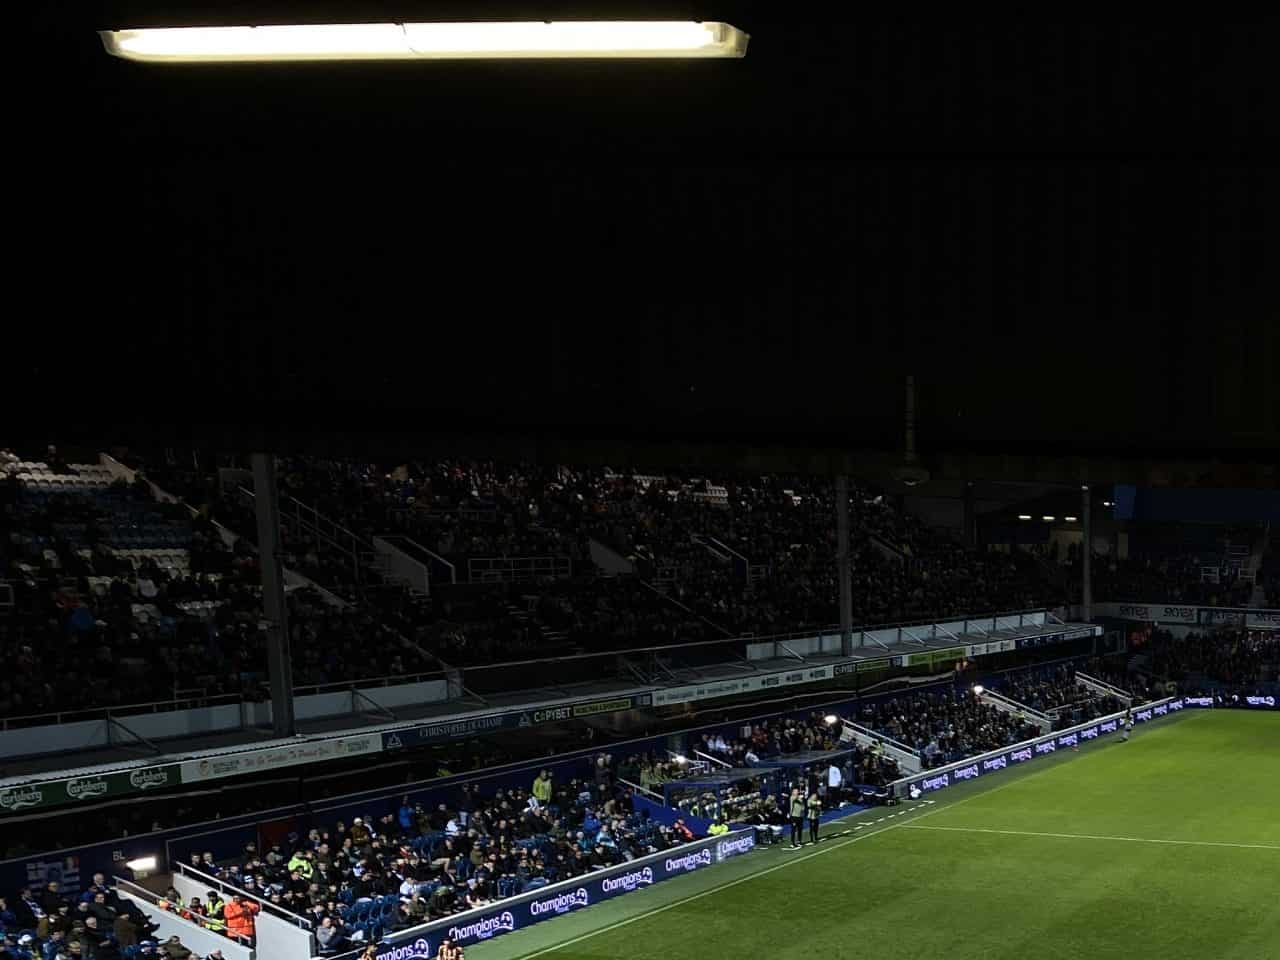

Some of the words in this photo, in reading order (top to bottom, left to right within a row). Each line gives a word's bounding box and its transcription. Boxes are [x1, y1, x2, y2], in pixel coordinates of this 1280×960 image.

[66, 776, 108, 798] Carlsberg
[130, 767, 168, 789] Carlsberg
[0, 786, 43, 808] Carlsberg
[666, 852, 701, 872] Champions
[602, 870, 642, 892] Champions
[531, 892, 576, 915] Champions
[449, 917, 500, 942] Champions
